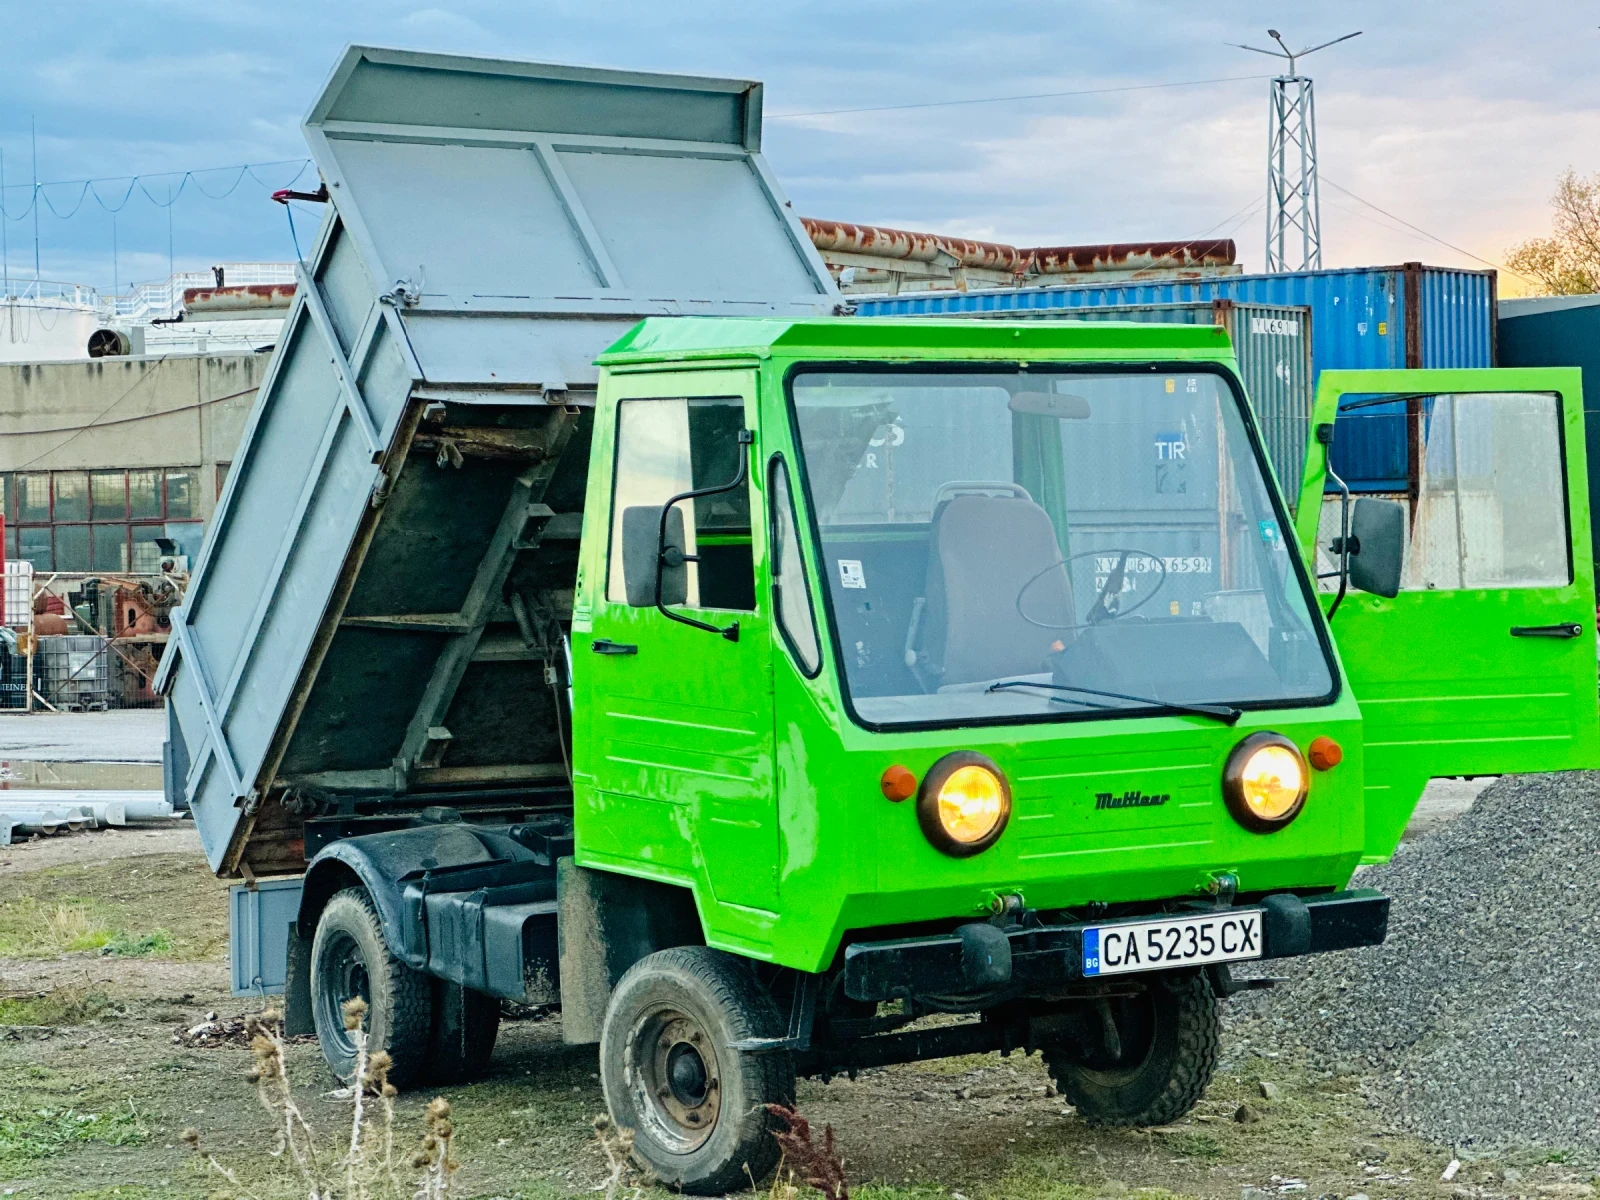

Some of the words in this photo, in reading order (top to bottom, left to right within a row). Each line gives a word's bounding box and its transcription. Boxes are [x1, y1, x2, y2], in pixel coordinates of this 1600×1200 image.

[1154, 441, 1186, 460] TIR
[1, 683, 28, 691] TEINE
[1095, 791, 1170, 810] Multicar
[1086, 957, 1099, 969] BG
